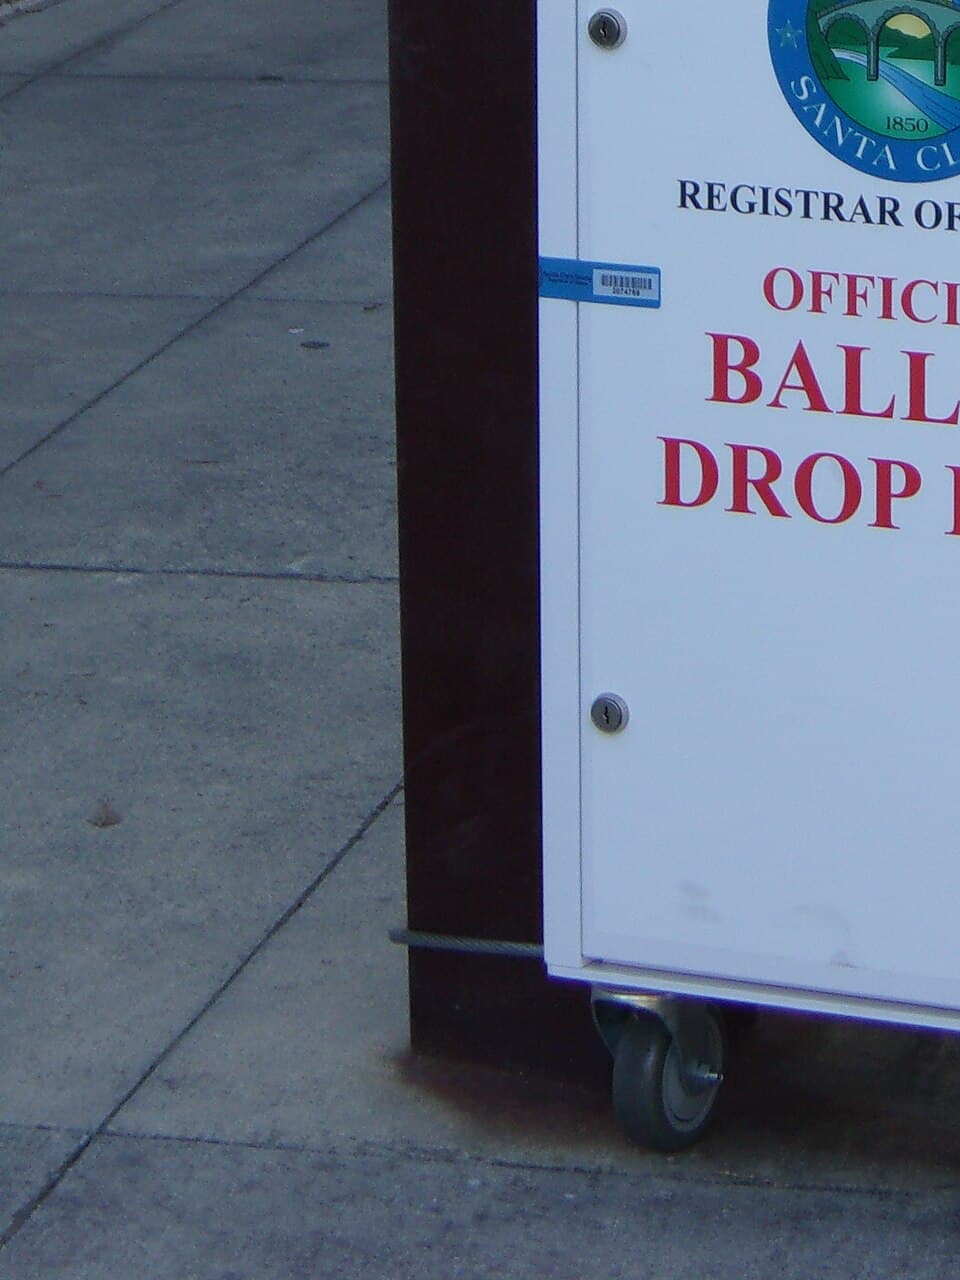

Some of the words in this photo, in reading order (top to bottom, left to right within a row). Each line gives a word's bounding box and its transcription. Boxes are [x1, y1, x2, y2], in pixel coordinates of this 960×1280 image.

[790, 75, 897, 171] SANTA
[886, 115, 929, 133] 1850
[677, 179, 904, 227] REGISTRAR
[656, 435, 923, 531] DROP
